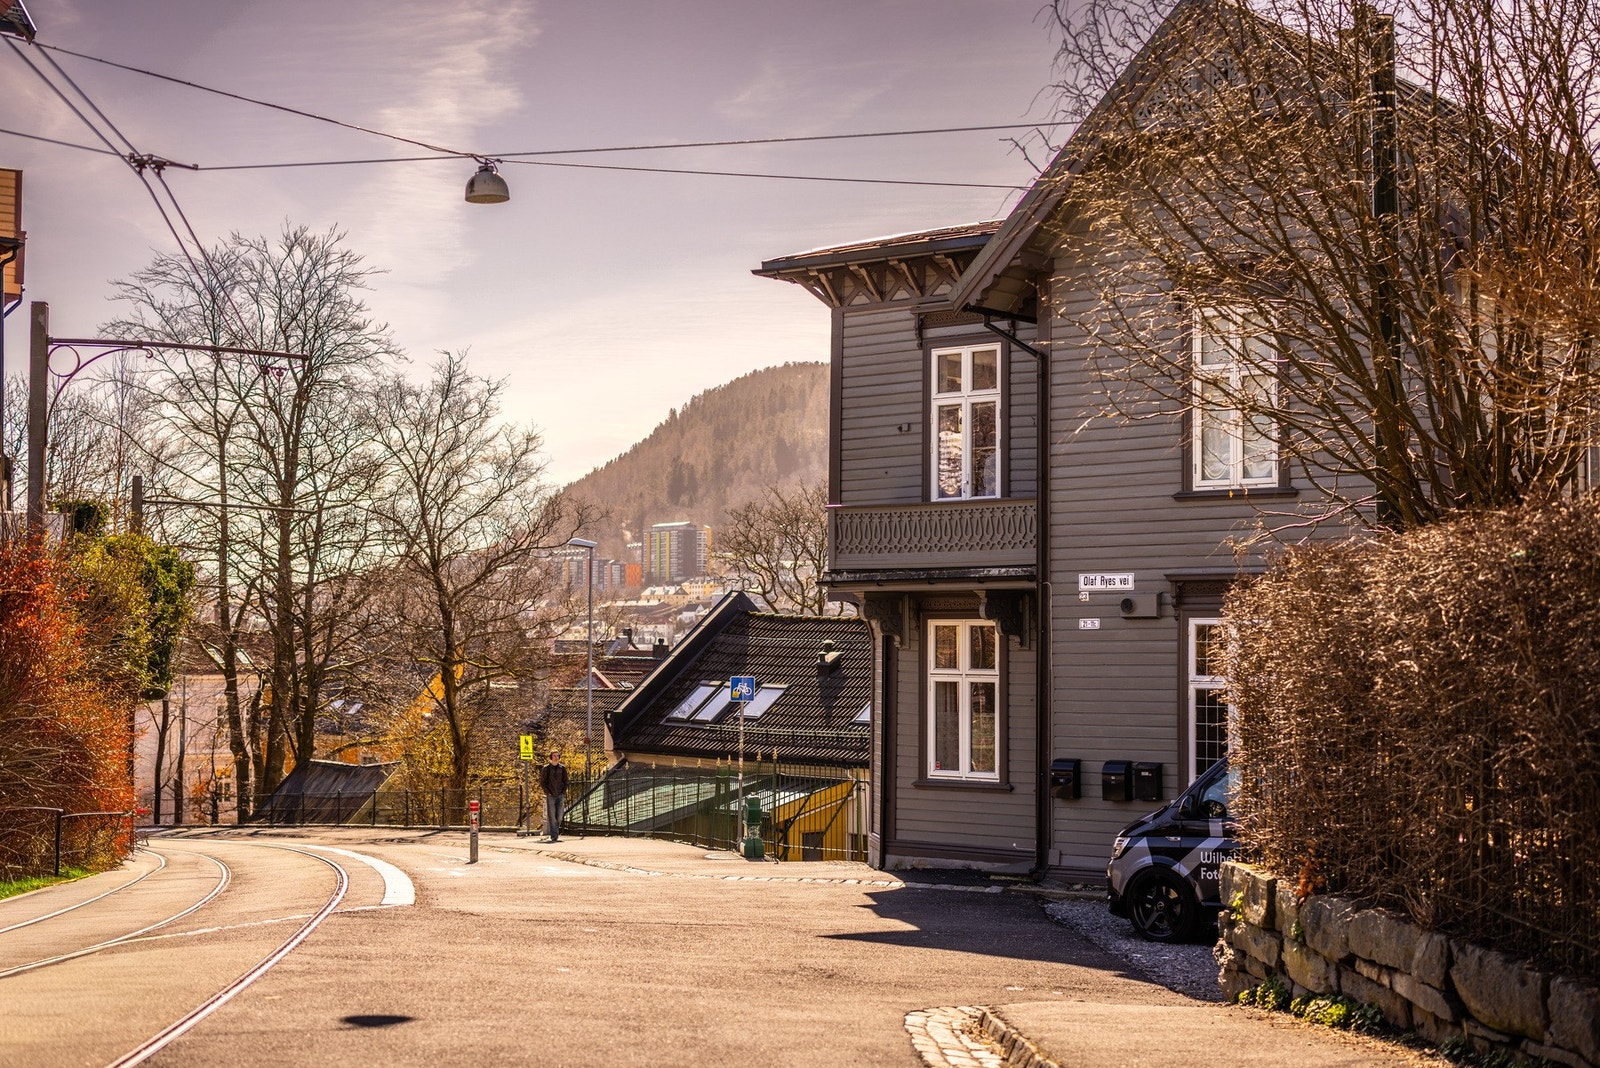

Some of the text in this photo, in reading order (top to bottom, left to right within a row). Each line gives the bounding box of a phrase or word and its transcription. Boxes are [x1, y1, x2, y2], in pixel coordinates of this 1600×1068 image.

[1083, 576, 1130, 588] Olaf Ryes vei
[1200, 867, 1221, 880] Fot
